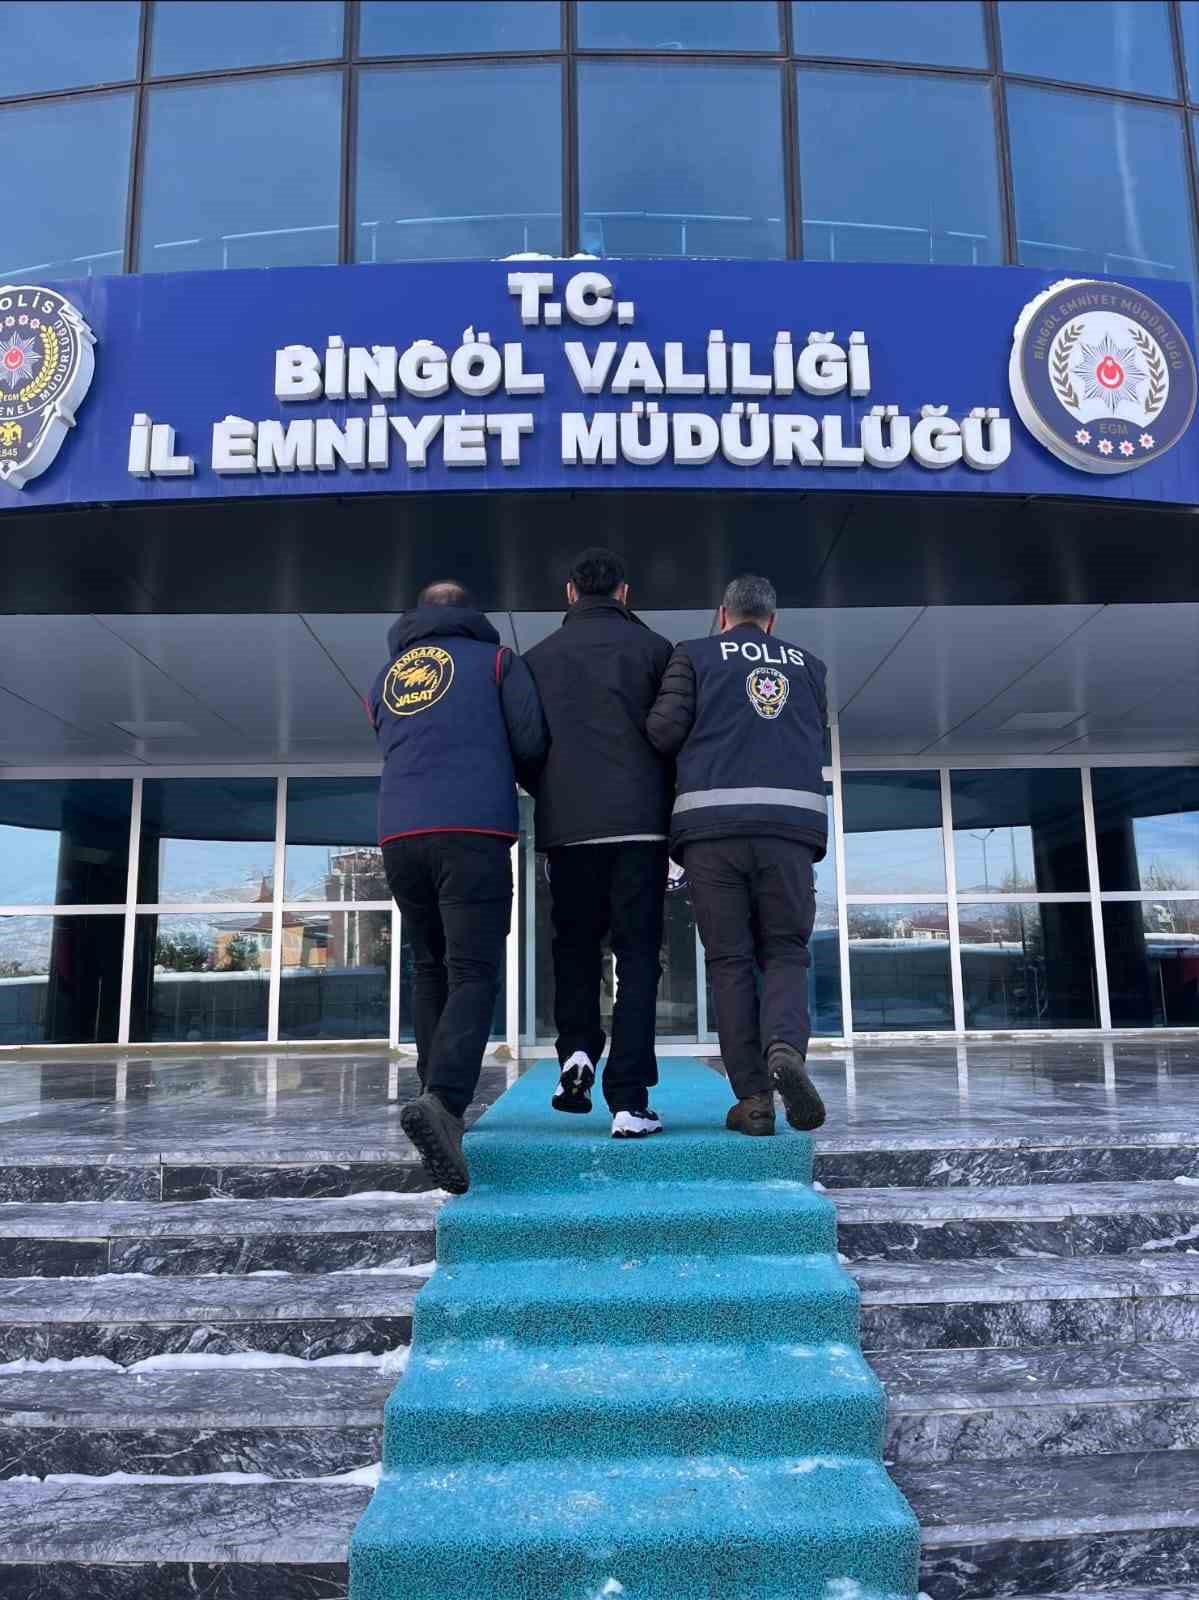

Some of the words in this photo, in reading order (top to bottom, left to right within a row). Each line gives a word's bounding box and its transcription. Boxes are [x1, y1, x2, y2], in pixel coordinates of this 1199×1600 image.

[0, 292, 54, 314] OLİS
[507, 272, 634, 326] T.C.
[274, 331, 545, 401] BİNGÖL
[564, 329, 871, 397] VALİLİĞİ
[128, 413, 194, 478] İL
[211, 405, 534, 475] EMNİYET
[561, 401, 1012, 471] MÜDÜRLÜĞÜ
[391, 648, 449, 676] JANDARMA
[395, 690, 433, 708] JASAT
